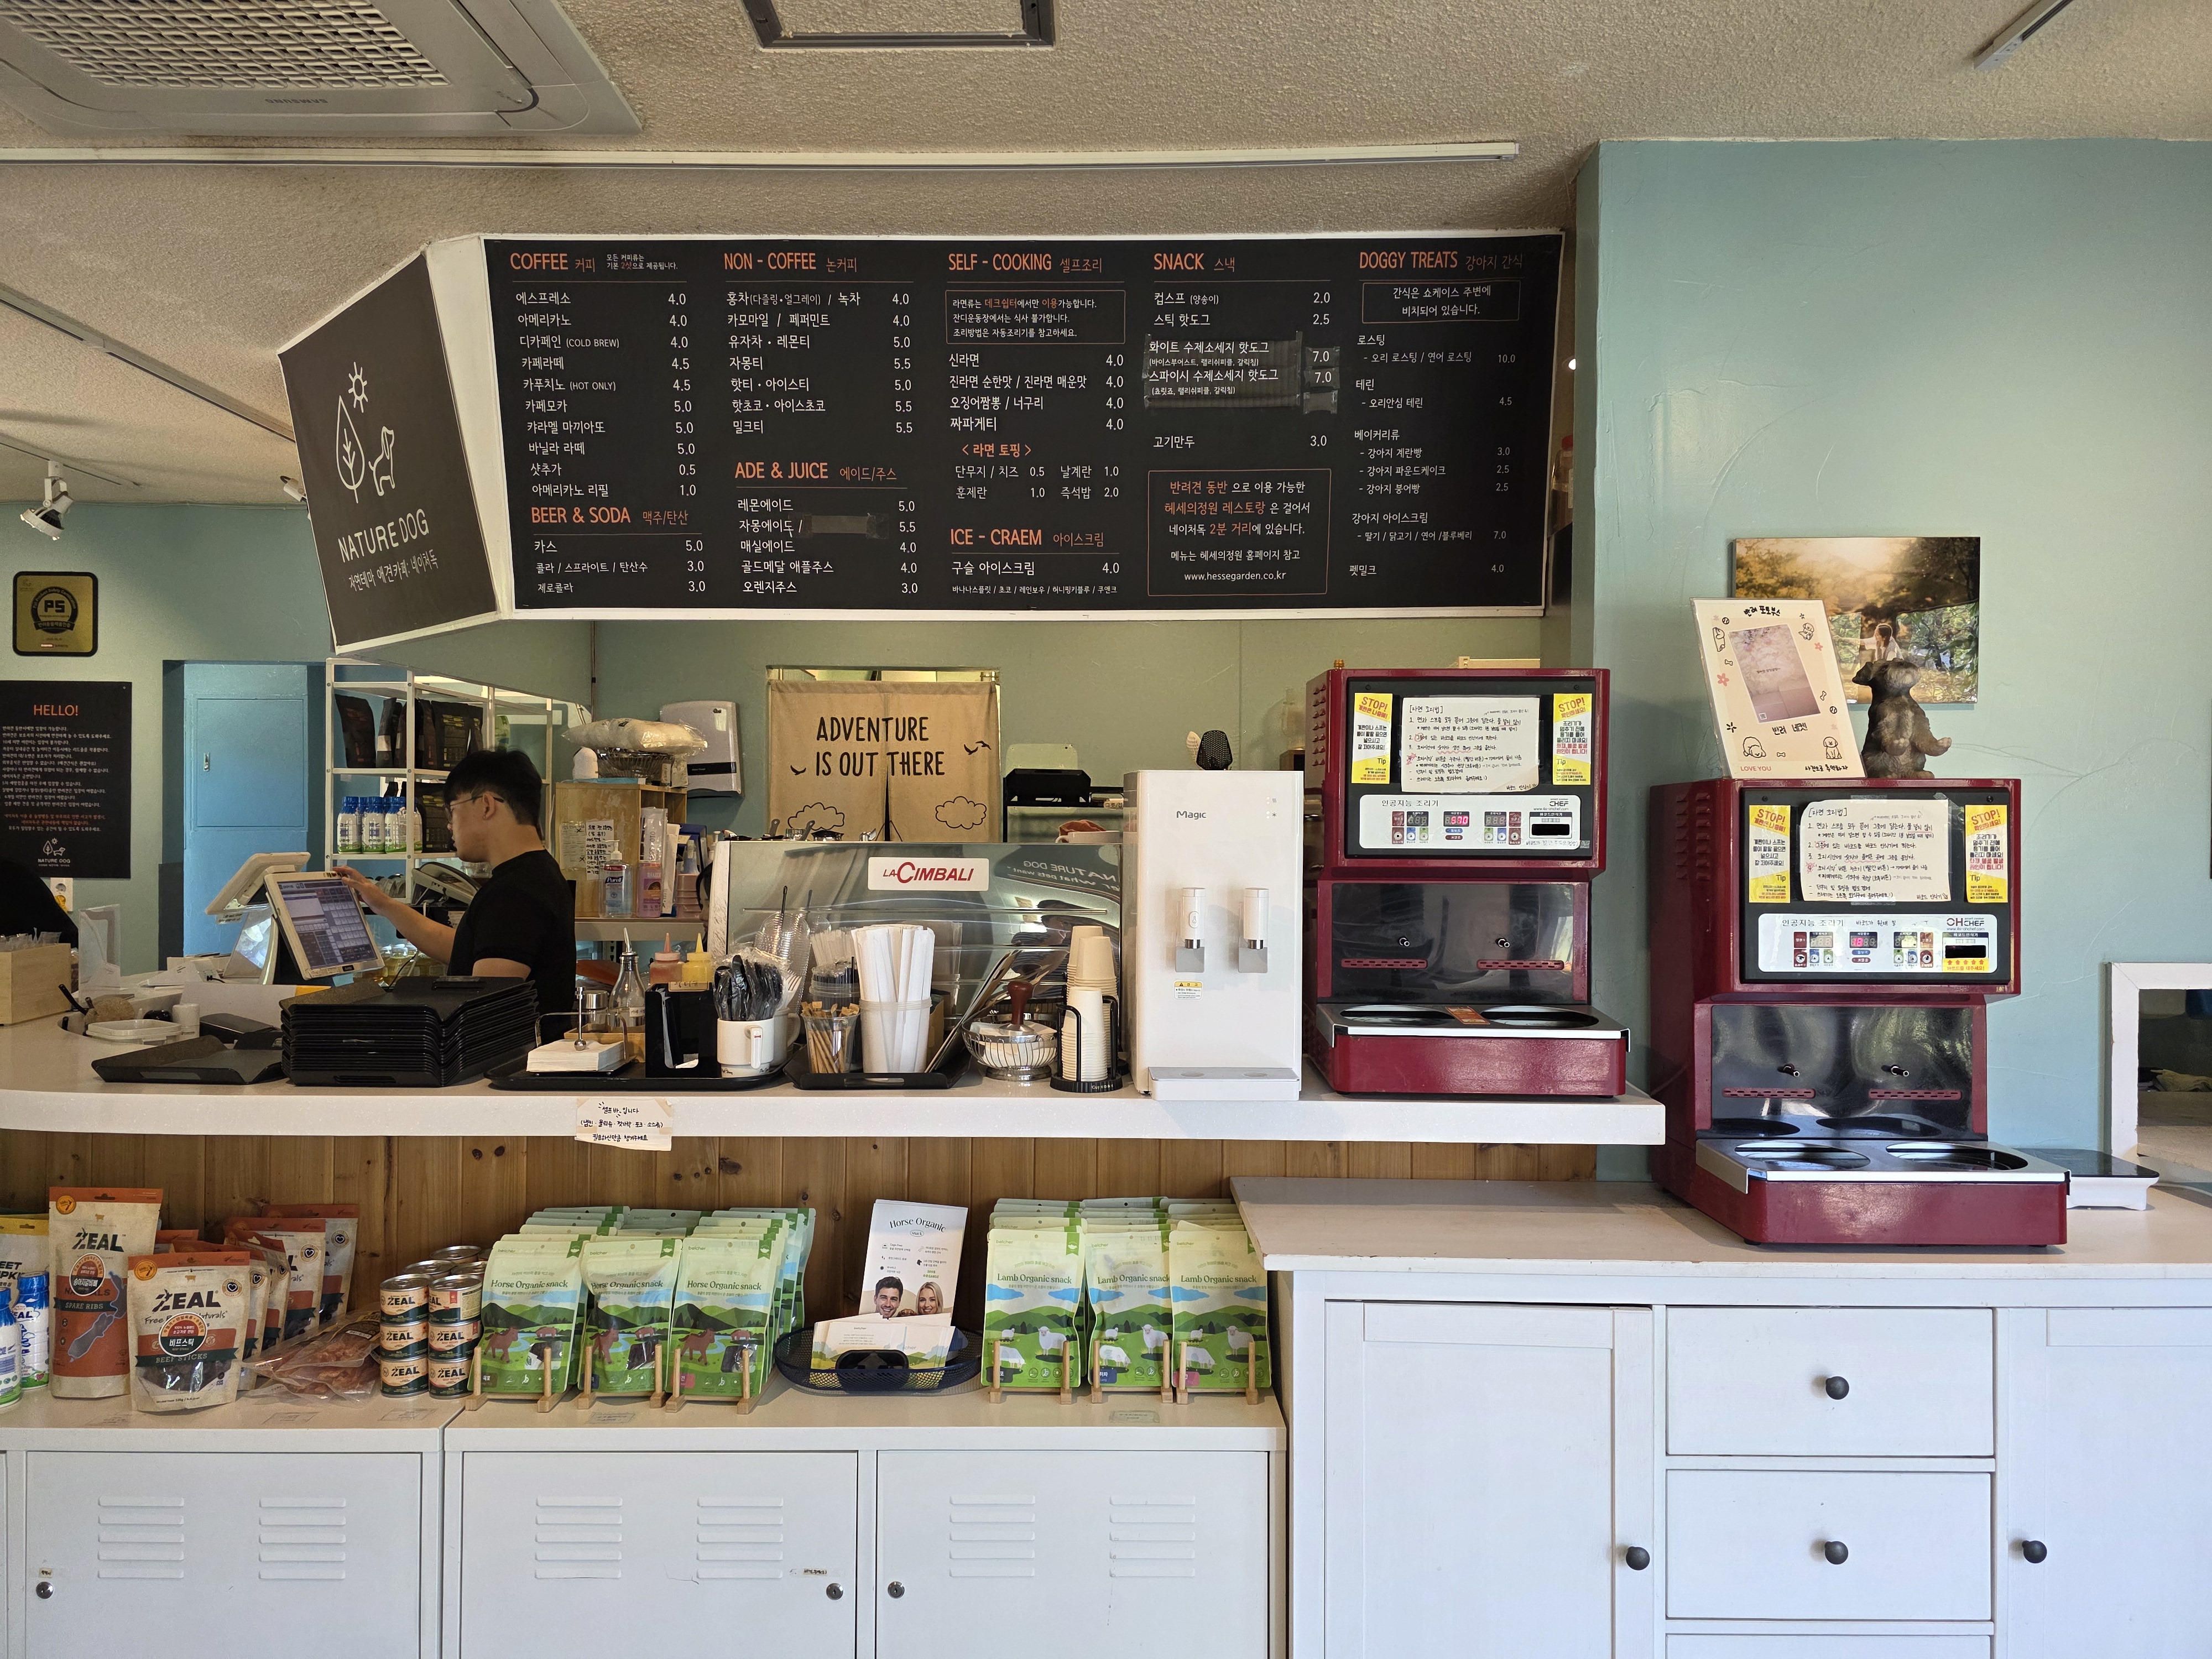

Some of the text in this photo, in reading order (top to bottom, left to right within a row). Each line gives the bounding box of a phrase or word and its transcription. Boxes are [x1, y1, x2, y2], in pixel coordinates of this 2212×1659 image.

[510, 252, 596, 273] COFFEE 커피
[724, 252, 857, 273] NON COFFEE 논커피
[948, 253, 1102, 274] SELF COOKING 셀프조리
[1154, 252, 1235, 273] SNACK 스낵
[1359, 251, 1522, 271] DOGGY TREATS 강아지 간식
[515, 291, 686, 306] 에스프레소 4.0
[1154, 291, 1331, 306] 컵스프 2.0
[518, 313, 572, 327] 아메리카노
[727, 312, 831, 327] 카모마일 페퍼민트
[1154, 313, 1211, 327] 스틱 핫도그
[519, 334, 619, 349] 디카페인 (COLD BREW)
[728, 334, 810, 349] 유자차 레몬티
[1357, 333, 1385, 346] 로스팅
[521, 356, 564, 371] 카페라떼
[729, 356, 763, 371] 자몽티
[948, 353, 979, 367] 신라면
[523, 377, 616, 392] 카푸치노 (HOT ONLY)
[949, 374, 1087, 389] 진라면 순한맛 진라면 매운맛
[732, 398, 826, 414] 핫초코 아이스초코
[562, 420, 606, 435] 마끼아또
[1354, 429, 1400, 441] 베이커리류
[1152, 435, 1195, 448] 고기만두
[973, 442, 1020, 458] 라면 토핑
[530, 462, 562, 476] 샷추가
[734, 461, 896, 482] ADE & JUICE 에이드/주스
[531, 483, 696, 497] 아메리카노 리필 1.0
[1170, 480, 1228, 494] 반려견 동반
[737, 498, 794, 512] 레몬에이드
[531, 507, 689, 526] BEER & SODA 맥주/탄산
[338, 508, 429, 563] NATURE DOG
[950, 528, 1104, 547] ICE CRAEM 아이스크림
[534, 539, 558, 554] 카스
[348, 571, 374, 592] 자연테마
[411, 549, 439, 574] 네이처독
[535, 561, 648, 574] 콜라 스프라이트 탄산수
[1349, 564, 1377, 576] 펫밀크
[1184, 570, 1287, 582] www.hessegarden.co.kr
[742, 580, 918, 594] 오렌지주스 3.0
[34, 705, 79, 716] HELLO!
[1361, 696, 1388, 712] STOP!
[1558, 697, 1585, 712] STOP!
[816, 717, 929, 742] ADVENTURE
[1772, 726, 1787, 735] 반려
[816, 751, 945, 776] IS OUT THERE
[1381, 799, 1412, 807] 인공지능
[1176, 811, 1207, 820] Magic
[1757, 808, 1786, 825] STOP!
[1971, 809, 2000, 825] STOP!
[1782, 919, 1844, 927] 인공지능 조리기
[890, 1218, 946, 1232] Horse Organic
[72, 1227, 124, 1252] ZEAL
[515, 1281, 546, 1289] Organic
[687, 1280, 708, 1288] Horse
[710, 1281, 739, 1290] Organic
[1204, 1275, 1233, 1284] Organic
[152, 1288, 221, 1312] ZEAL
[388, 1296, 415, 1306] ZEAL
[145, 1316, 164, 1324] Free
[169, 1338, 194, 1347] 비프스틱
[392, 1366, 420, 1376] ZEAL
[437, 1368, 466, 1378] ZEAL
